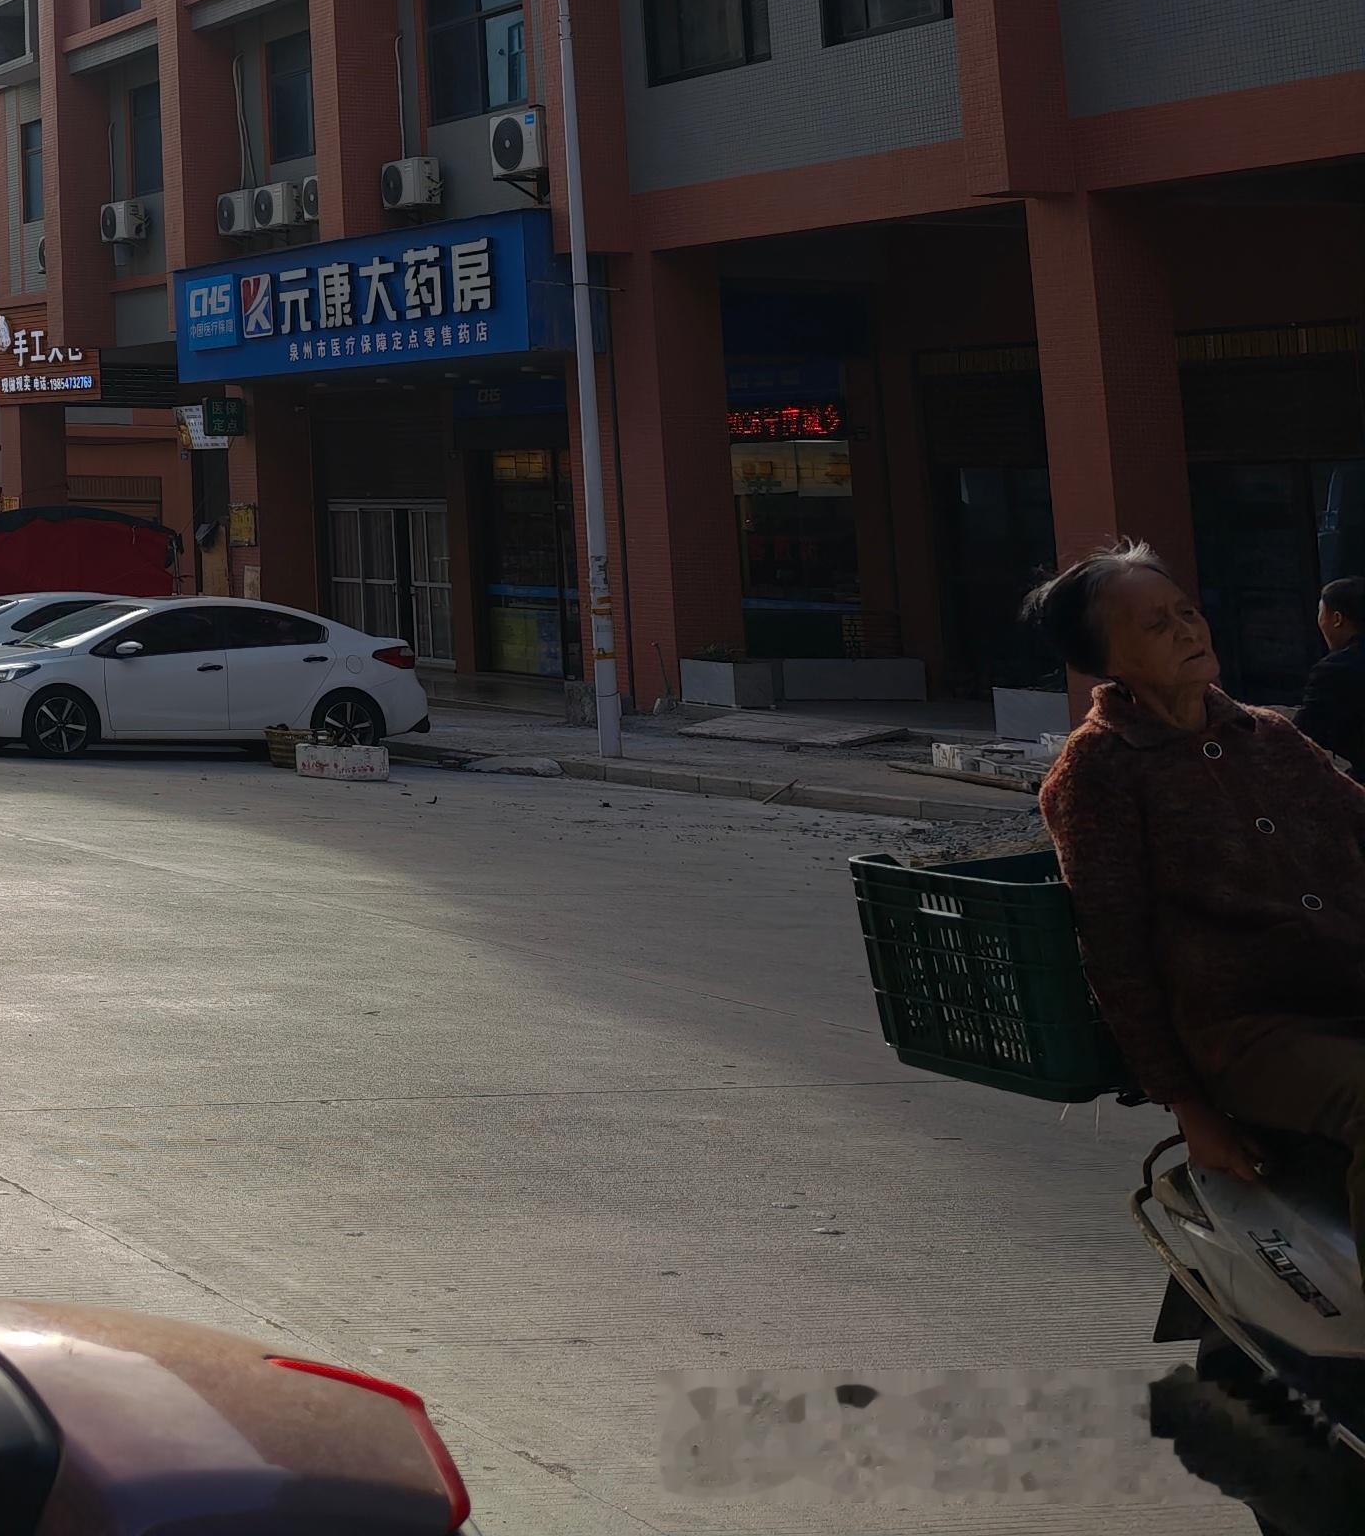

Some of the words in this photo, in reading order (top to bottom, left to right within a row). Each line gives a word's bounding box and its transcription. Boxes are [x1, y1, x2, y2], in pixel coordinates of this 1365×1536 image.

[279, 238, 492, 334] 元康大药房
[190, 284, 231, 318] CHS
[190, 319, 234, 338] 中国医疗保障
[289, 320, 489, 362] 泉州市医疗保障定点零售药店
[212, 401, 238, 415] 医保
[212, 418, 238, 432] 定点
